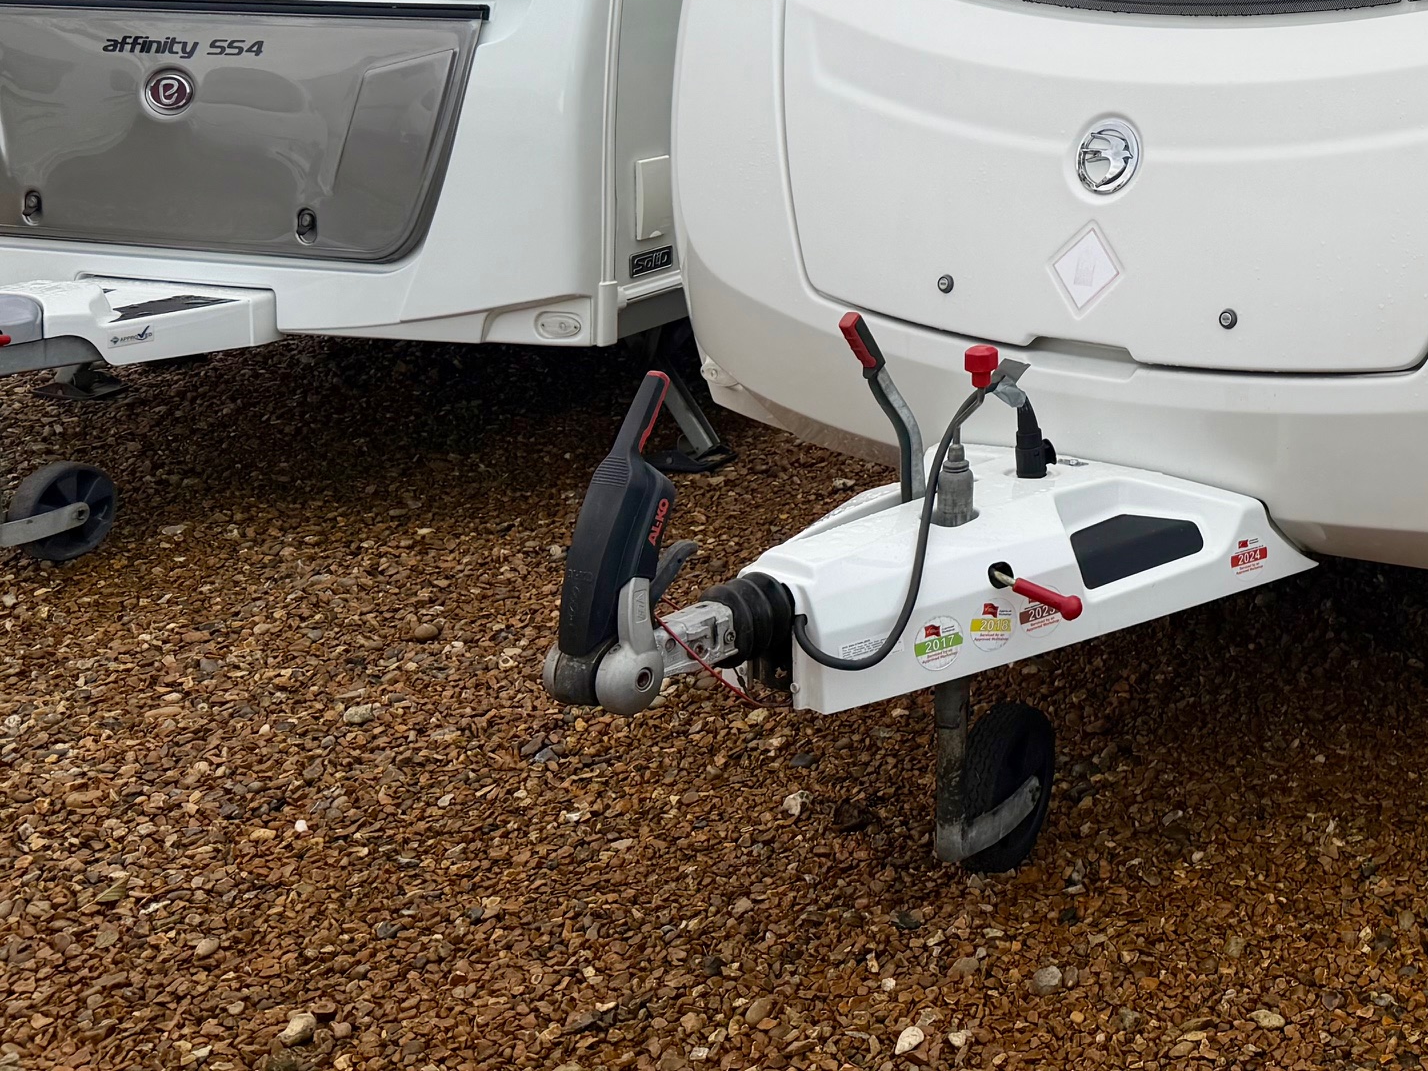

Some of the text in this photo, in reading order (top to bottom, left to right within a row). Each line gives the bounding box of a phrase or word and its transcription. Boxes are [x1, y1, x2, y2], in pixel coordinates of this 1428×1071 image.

[102, 35, 265, 59] affinity 554
[648, 498, 671, 546] AL-KO
[1238, 549, 1260, 565] 2024
[980, 619, 1009, 631] 2018
[925, 635, 955, 653] 2017
